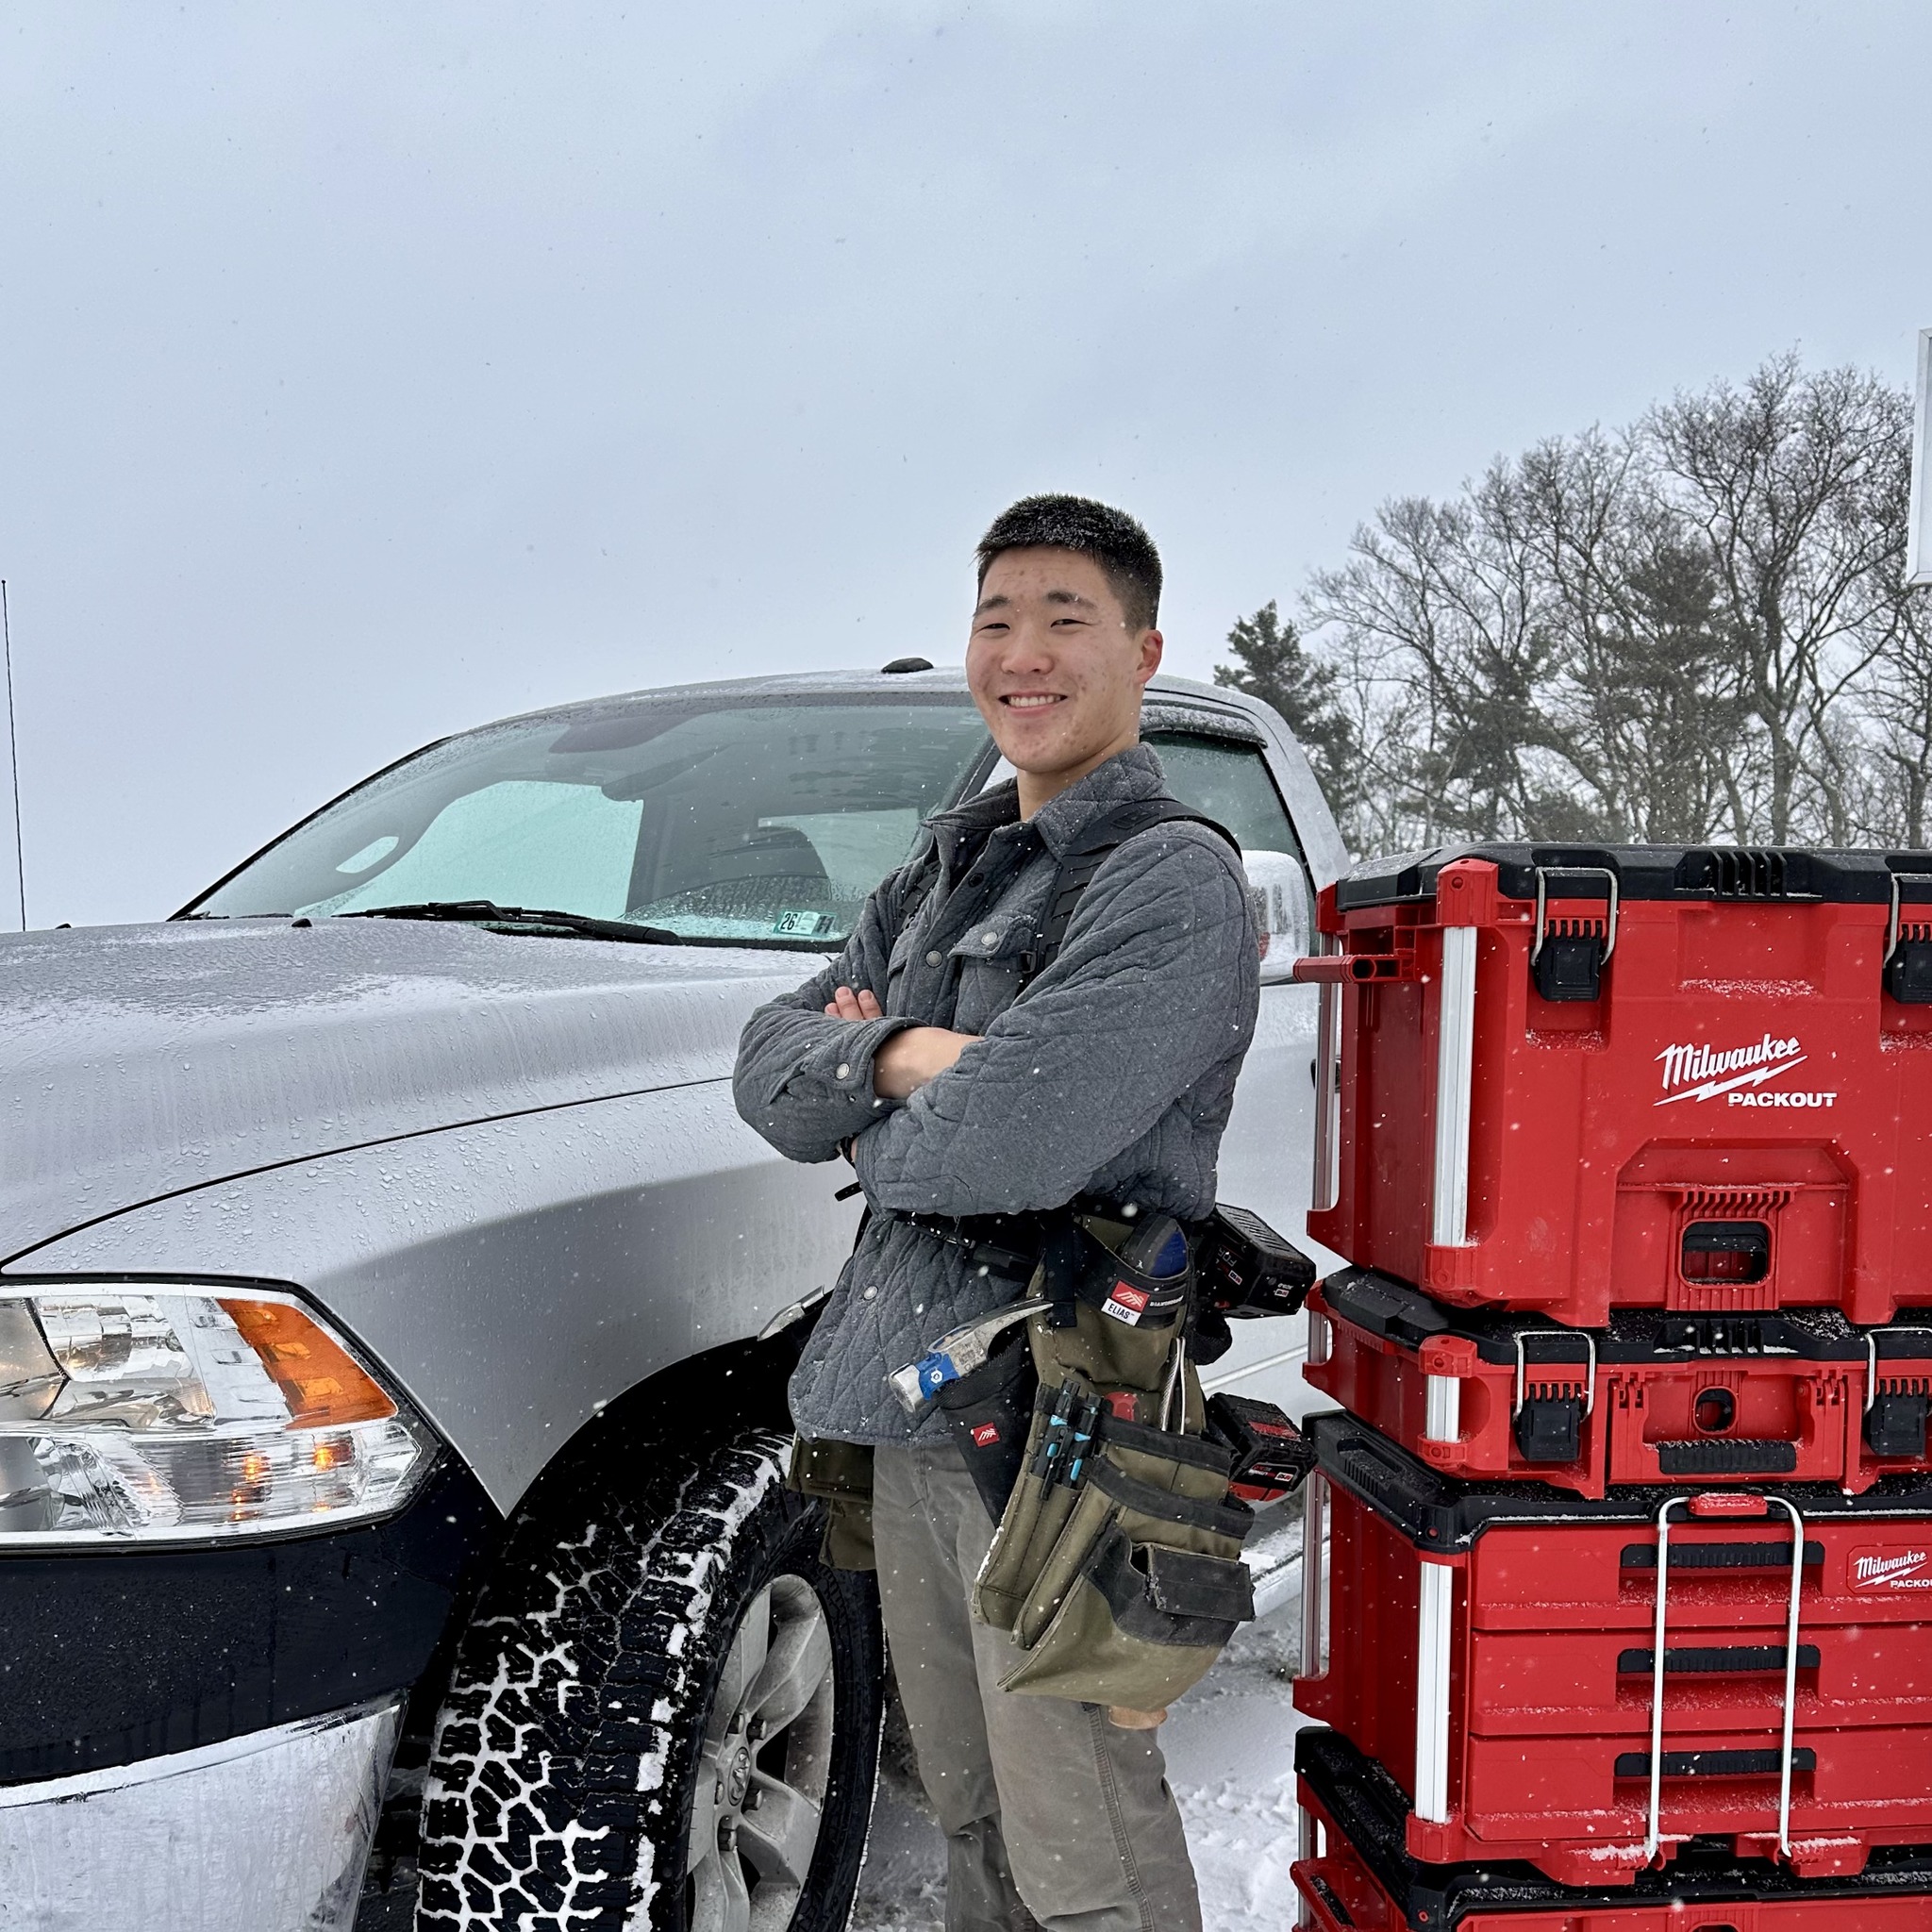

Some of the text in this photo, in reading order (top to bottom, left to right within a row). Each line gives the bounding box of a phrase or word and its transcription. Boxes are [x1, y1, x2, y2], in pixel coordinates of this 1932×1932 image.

[780, 912, 798, 930] 26
[1654, 1033, 1801, 1091] Milwaukee
[1728, 1092, 1837, 1108] PACKOUT
[1108, 1303, 1131, 1320] ELIAS
[1853, 1550, 1927, 1580] Milwaukee
[1890, 1578, 1932, 1589] PACKO
